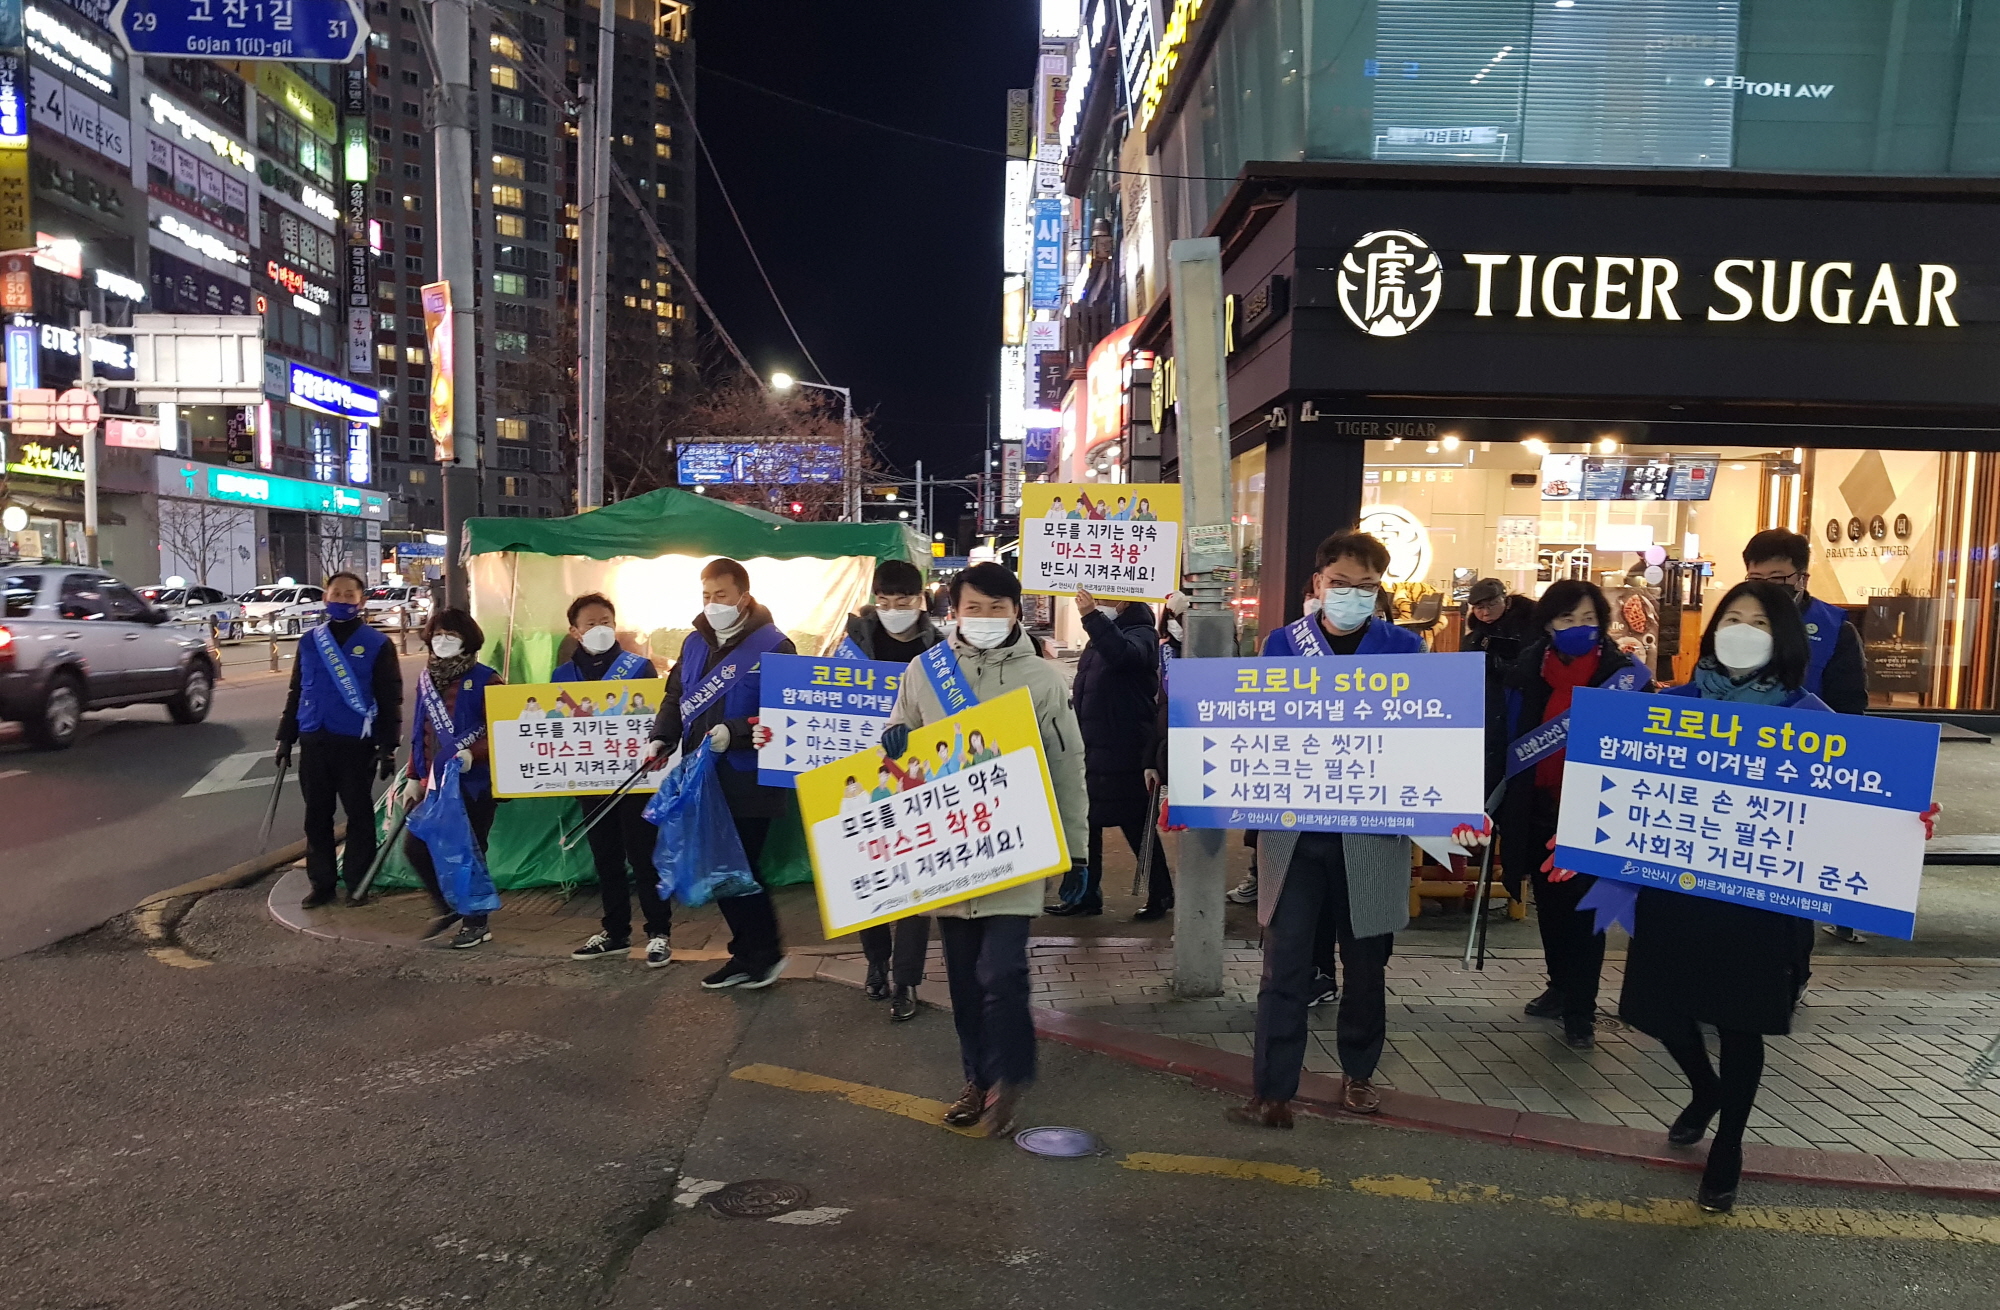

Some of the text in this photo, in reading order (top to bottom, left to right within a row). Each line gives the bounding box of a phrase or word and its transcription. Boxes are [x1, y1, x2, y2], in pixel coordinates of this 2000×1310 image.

[132, 12, 157, 32] 29
[327, 20, 347, 38] 31
[187, 36, 293, 55] Gojan 1(il)-gil
[69, 110, 122, 154] WEEKS
[1036, 219, 1060, 270] 사진
[1462, 252, 1960, 328] TIGER SUGAR
[1335, 421, 1437, 437] TIGER SUGAR
[1043, 522, 1158, 542] 모두를 지키는 약속
[1825, 545, 1910, 559] BRAVE AS A TIGER
[1040, 561, 1155, 582] 반드시 지켜주세요!
[1869, 586, 1900, 597] TIGER
[810, 665, 876, 691] 코로나
[1234, 666, 1410, 697] 코로나 stop
[782, 687, 893, 713] 함께하면 이겨낼
[941, 675, 967, 710] 마스크
[1197, 698, 1452, 722] 함께하면 이겨낼 수 있어요.
[518, 721, 565, 738] 모두를
[572, 720, 619, 736] 지키는
[806, 716, 875, 737] 수시로 손
[1642, 705, 1848, 763] 코로나 stop
[806, 735, 868, 751] 마스크는
[1230, 733, 1383, 755] 수시로 손 씻기!
[519, 761, 567, 778] 반드시
[1230, 758, 1375, 780] 마스크는 필수!
[1599, 735, 1892, 798] 함께하면 이겨낼 수 있어요.
[840, 763, 1008, 840] 모두를 지키는 약속
[1230, 782, 1442, 807] 사회적 거리두기 준수
[1631, 778, 1807, 825] 수시로 손 씻기!
[1297, 813, 1358, 827] 바르게살기운동
[1360, 814, 1415, 828] 안산시협의회
[1628, 804, 1795, 852] 마스크는 필수!
[850, 824, 1025, 901] 반드시 지켜주세요!
[1625, 830, 1870, 896] 사회적 거리두기 준수
[1641, 866, 1833, 915] 안산시/ 바르게살기운동 안산시협의회
